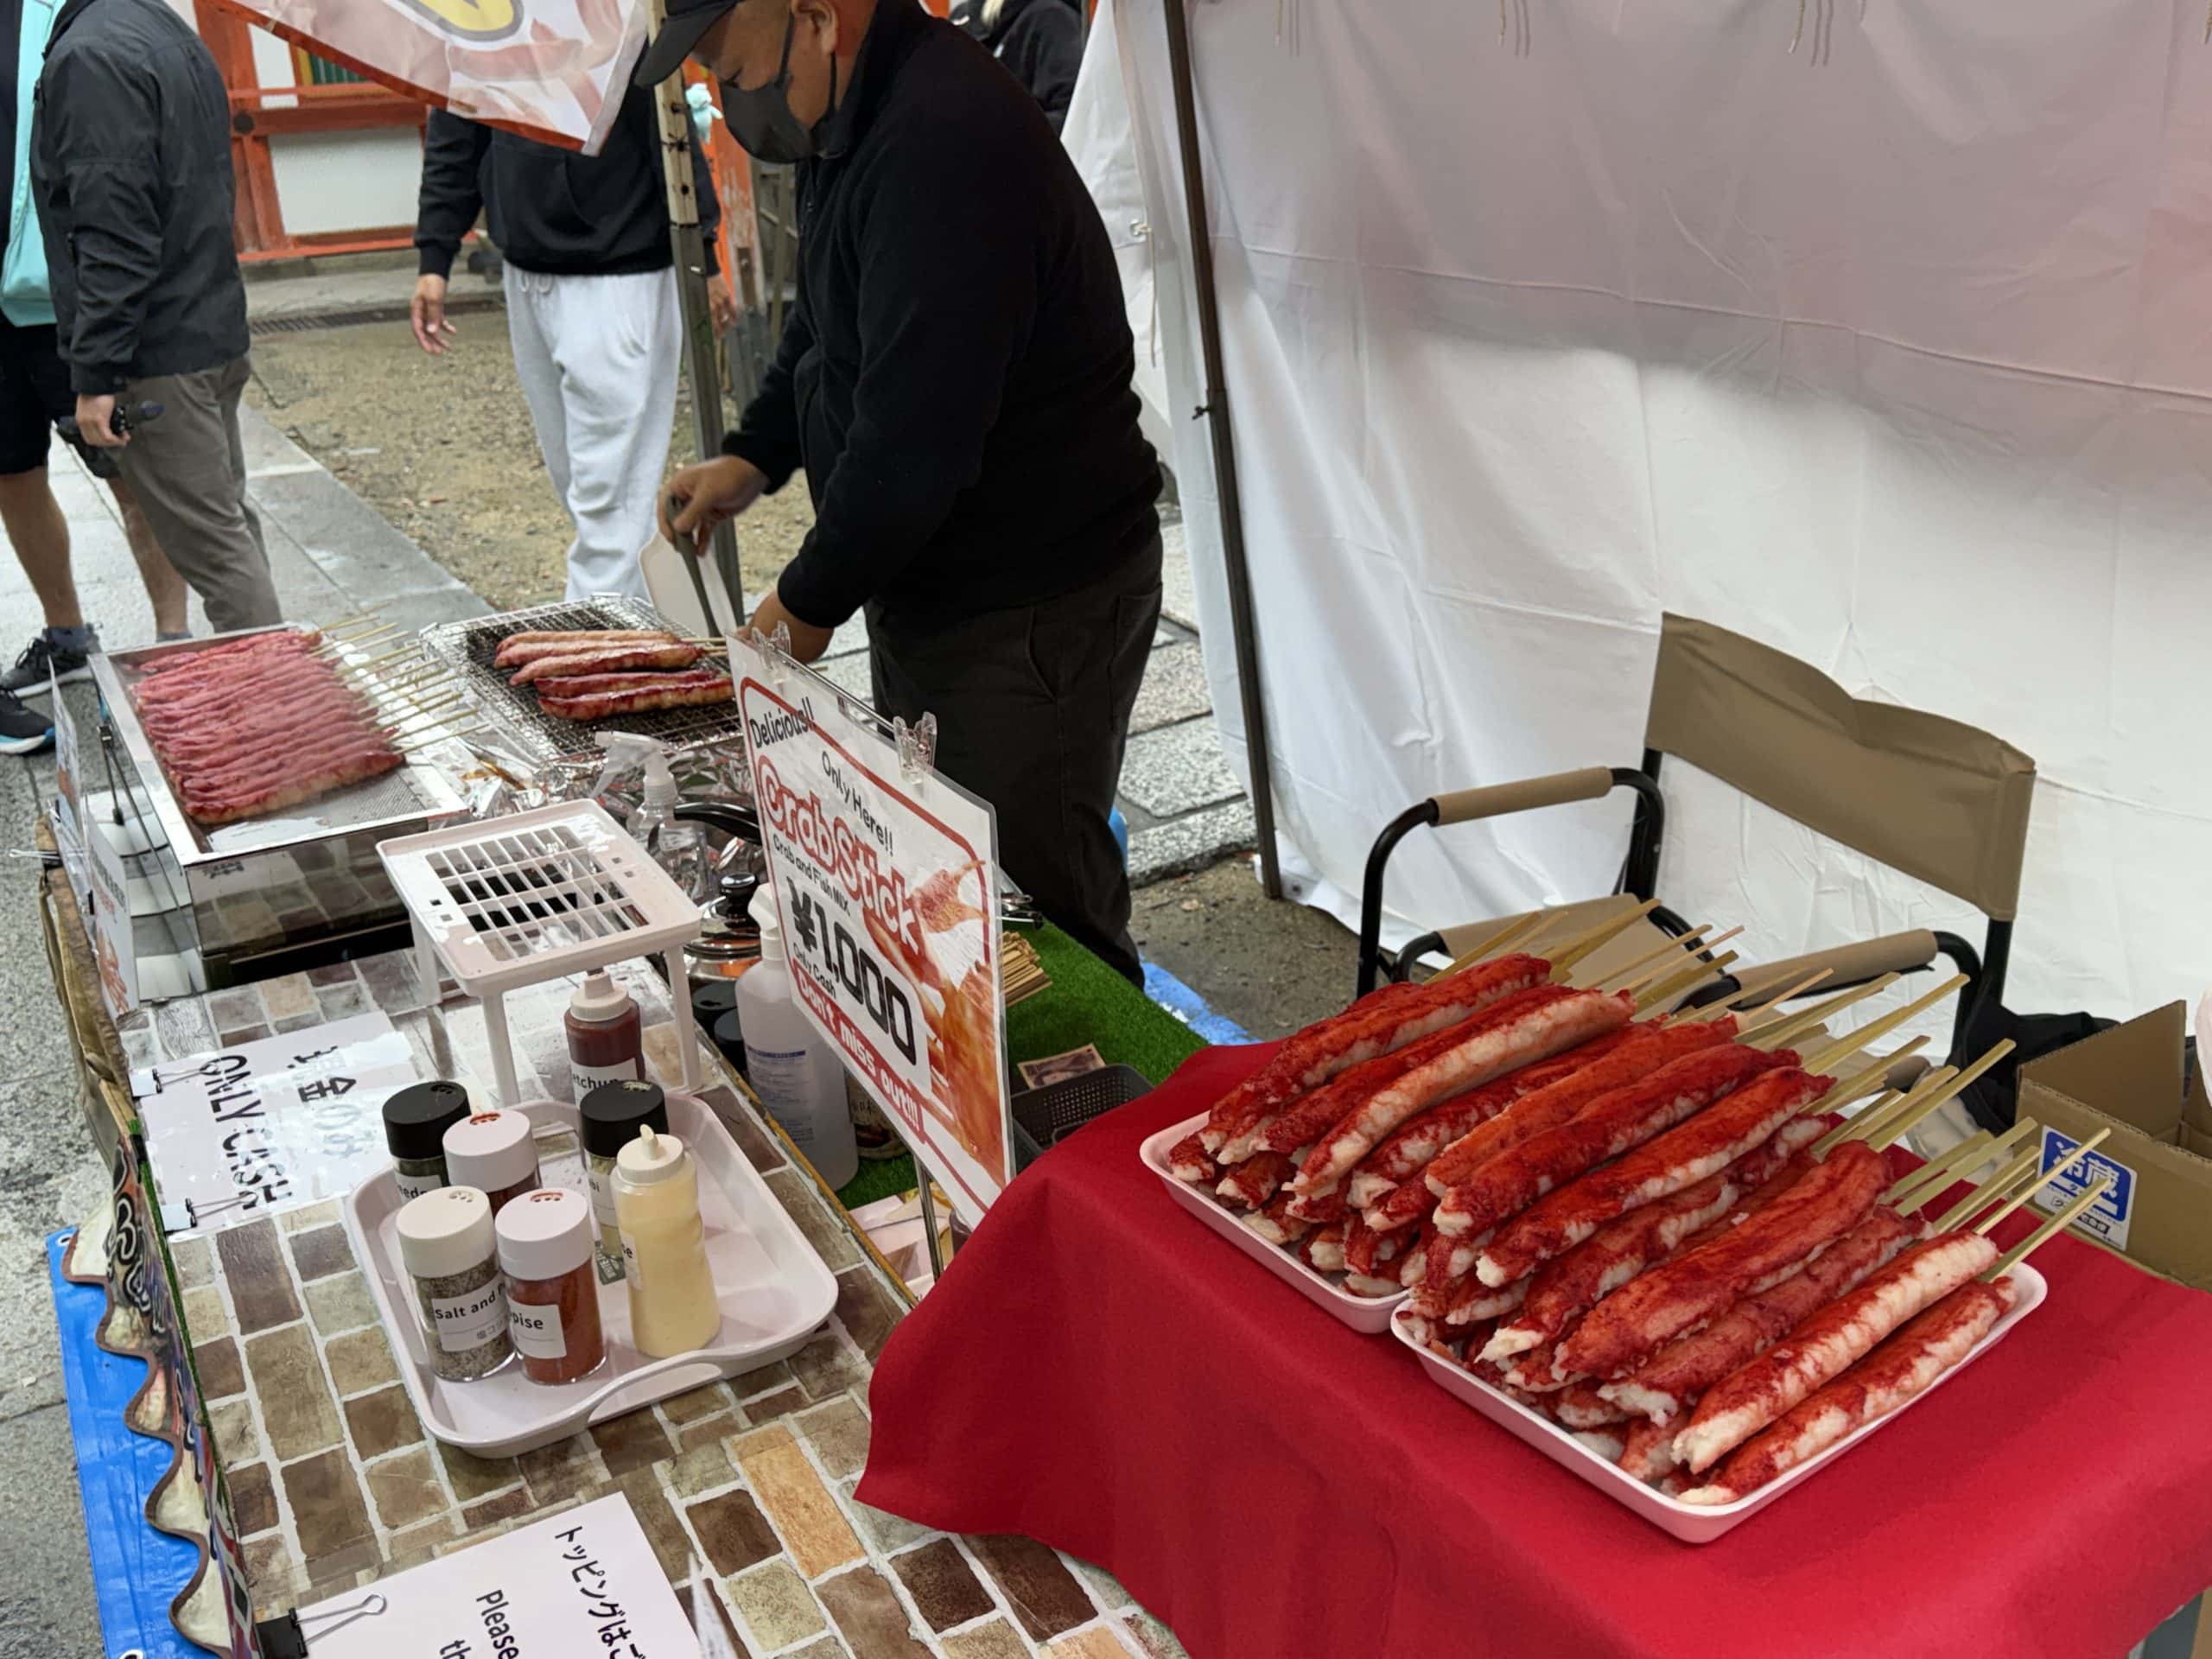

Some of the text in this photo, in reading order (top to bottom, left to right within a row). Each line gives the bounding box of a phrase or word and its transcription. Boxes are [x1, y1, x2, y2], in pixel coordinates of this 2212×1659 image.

[749, 696, 814, 749] Delicious!!
[822, 750, 893, 857] Only Here!!
[773, 833, 795, 864] Crab
[796, 856, 812, 880] and
[812, 866, 833, 899] Fish
[786, 875, 917, 1066] ¥1,000
[793, 942, 836, 1000] Only Cash
[798, 966, 836, 1033] Don't
[839, 1019, 877, 1077] miss
[199, 1054, 266, 1122] ONLY
[435, 1290, 496, 1320] Salt and
